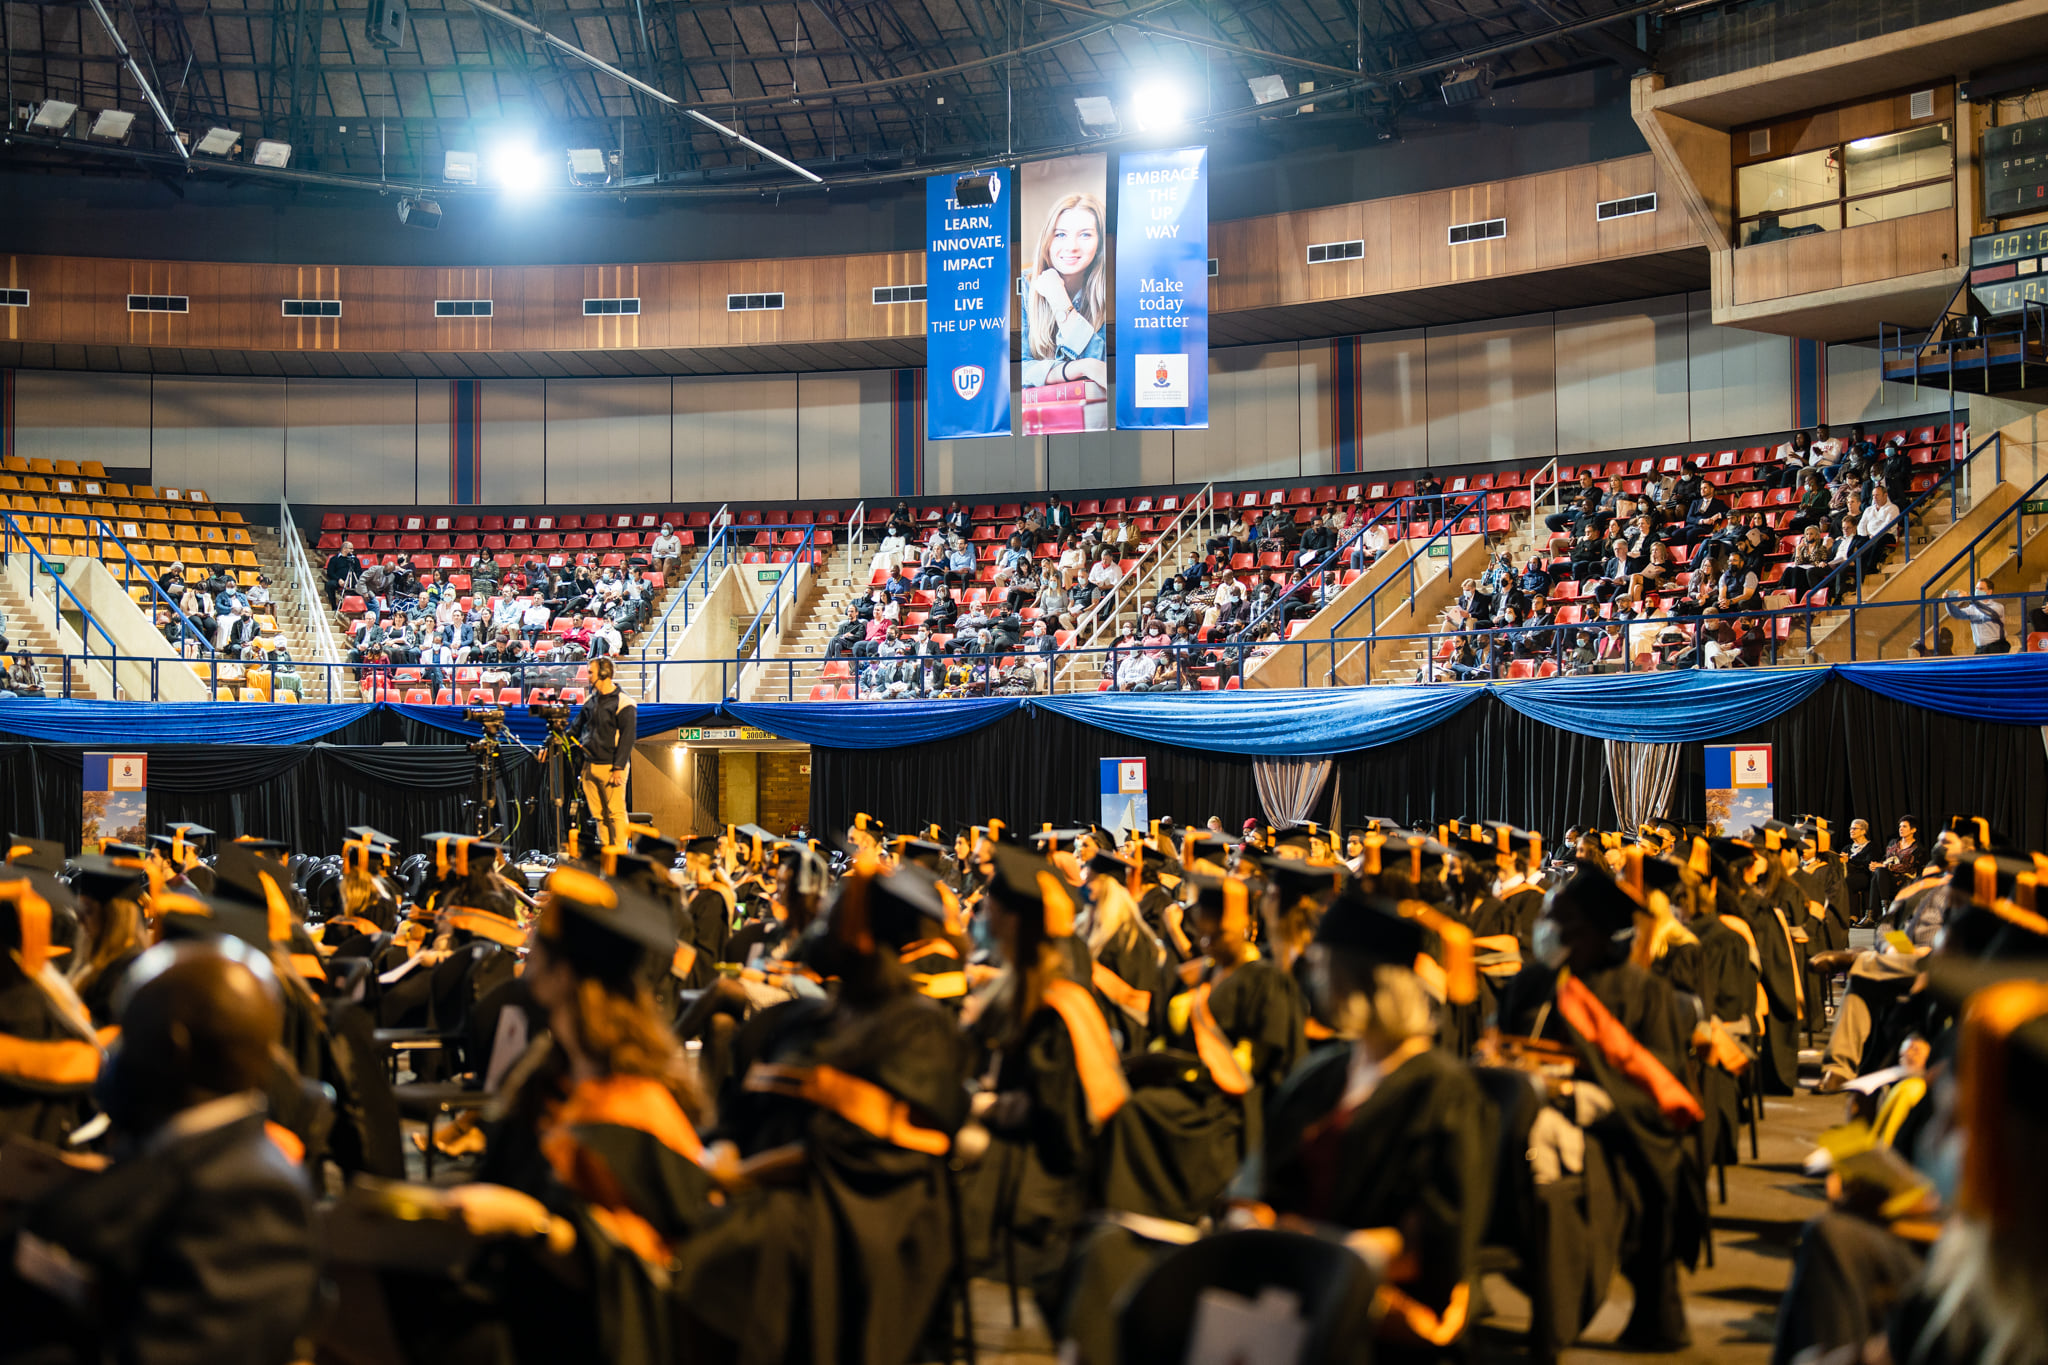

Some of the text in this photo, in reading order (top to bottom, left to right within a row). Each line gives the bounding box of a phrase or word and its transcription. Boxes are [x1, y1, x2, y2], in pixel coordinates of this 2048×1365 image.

[1127, 166, 1199, 186] EMBRACE
[1148, 187, 1178, 202] THE
[1151, 206, 1173, 220] UP
[944, 216, 993, 231] LEARN,
[1145, 224, 1180, 240] WAY
[932, 235, 1005, 253] INNOVATE,
[943, 256, 995, 272] IMPACT
[957, 278, 980, 291] and
[1139, 277, 1184, 293] Make
[954, 297, 984, 312] LIVE
[1139, 295, 1184, 314] today
[931, 316, 1006, 333] THE UP WAY
[1133, 315, 1190, 329] matter
[958, 374, 980, 390] UP
[2027, 502, 2044, 513] EXIT
[1433, 547, 1446, 555] EXIT
[763, 572, 775, 580] EXIT
